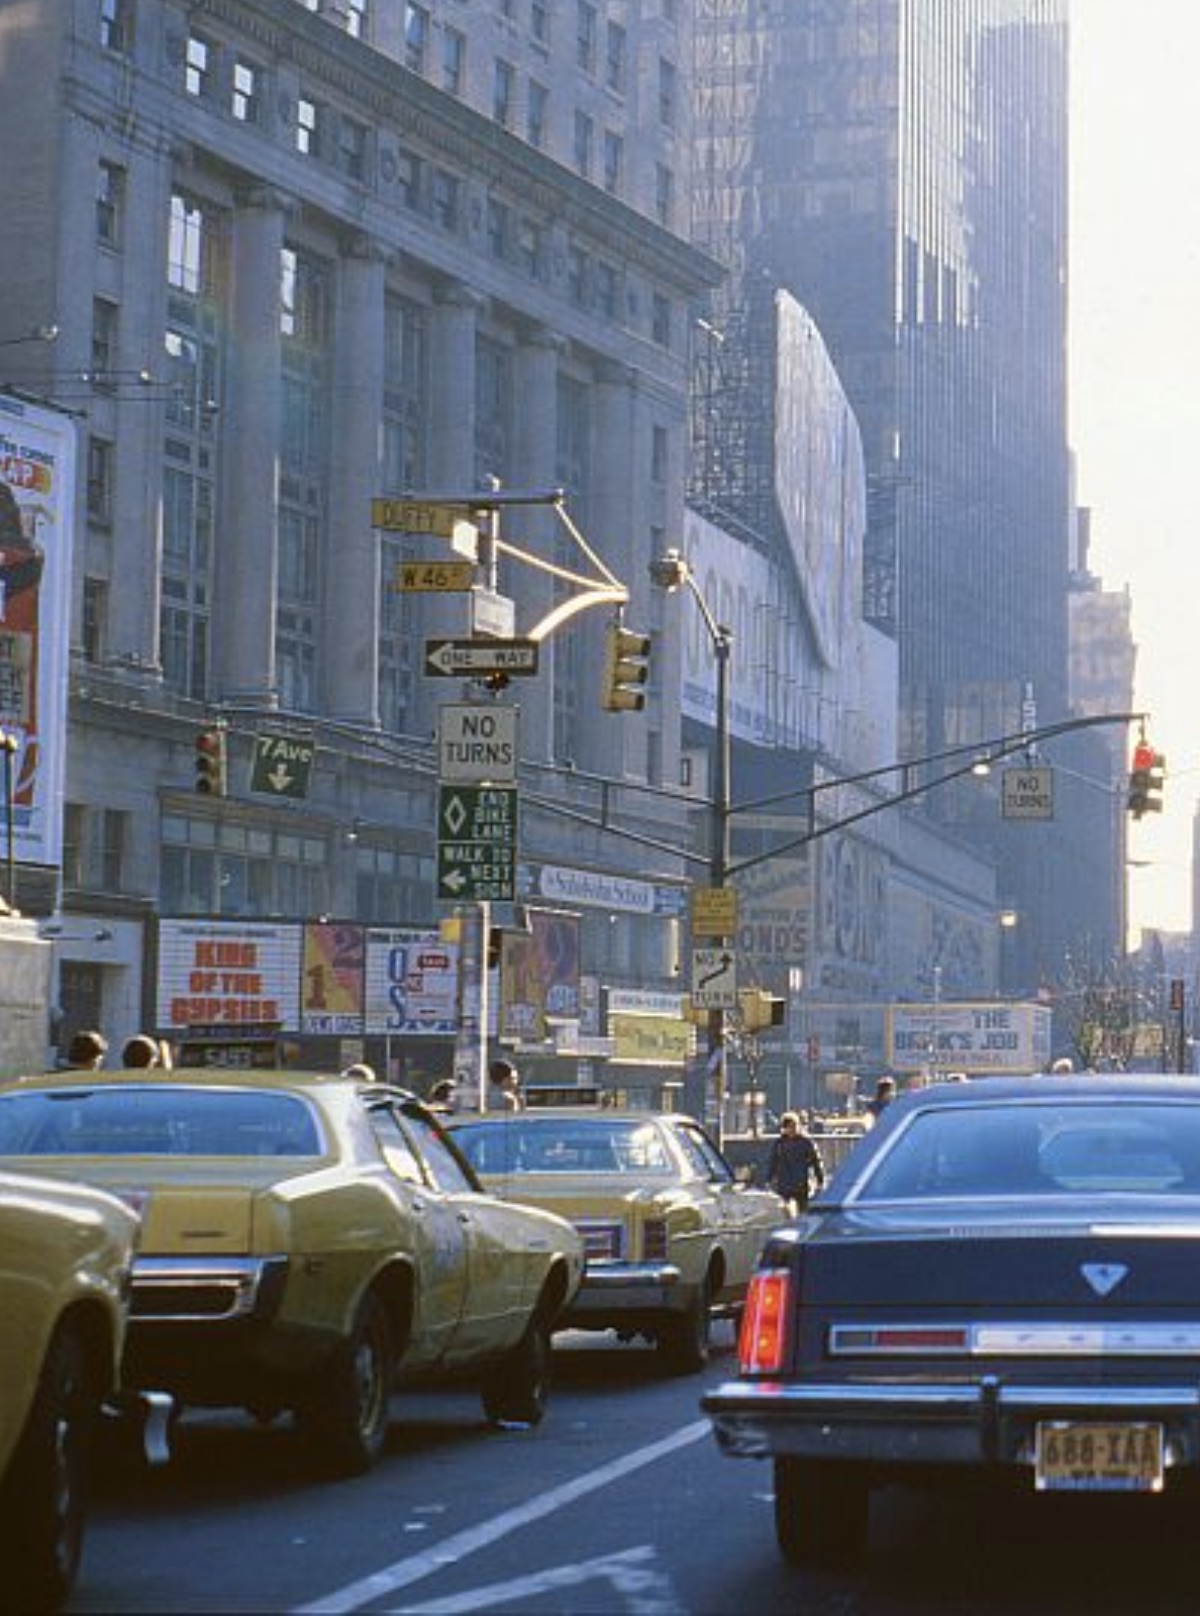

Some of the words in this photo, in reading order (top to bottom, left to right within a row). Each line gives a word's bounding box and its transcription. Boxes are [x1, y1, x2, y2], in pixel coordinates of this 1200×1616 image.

[403, 568, 416, 587] W
[440, 651, 474, 667] ONE
[494, 651, 528, 668] WAY
[462, 715, 495, 739] NO
[446, 742, 512, 765] TURNS
[1017, 778, 1039, 792] NO
[478, 790, 508, 806] END
[473, 807, 510, 823] BIKE
[472, 825, 511, 841] LANE
[443, 846, 486, 863] WALK
[491, 848, 511, 864] TO
[470, 864, 510, 881] NEXT
[473, 883, 511, 901] SIGN
[738, 923, 808, 948] OND'S
[195, 940, 258, 968] KING
[189, 971, 218, 994] OF
[219, 973, 262, 995] THE
[170, 997, 278, 1026] GYPSIES
[971, 1009, 1011, 1030] THE
[979, 1031, 1019, 1050] JOB
